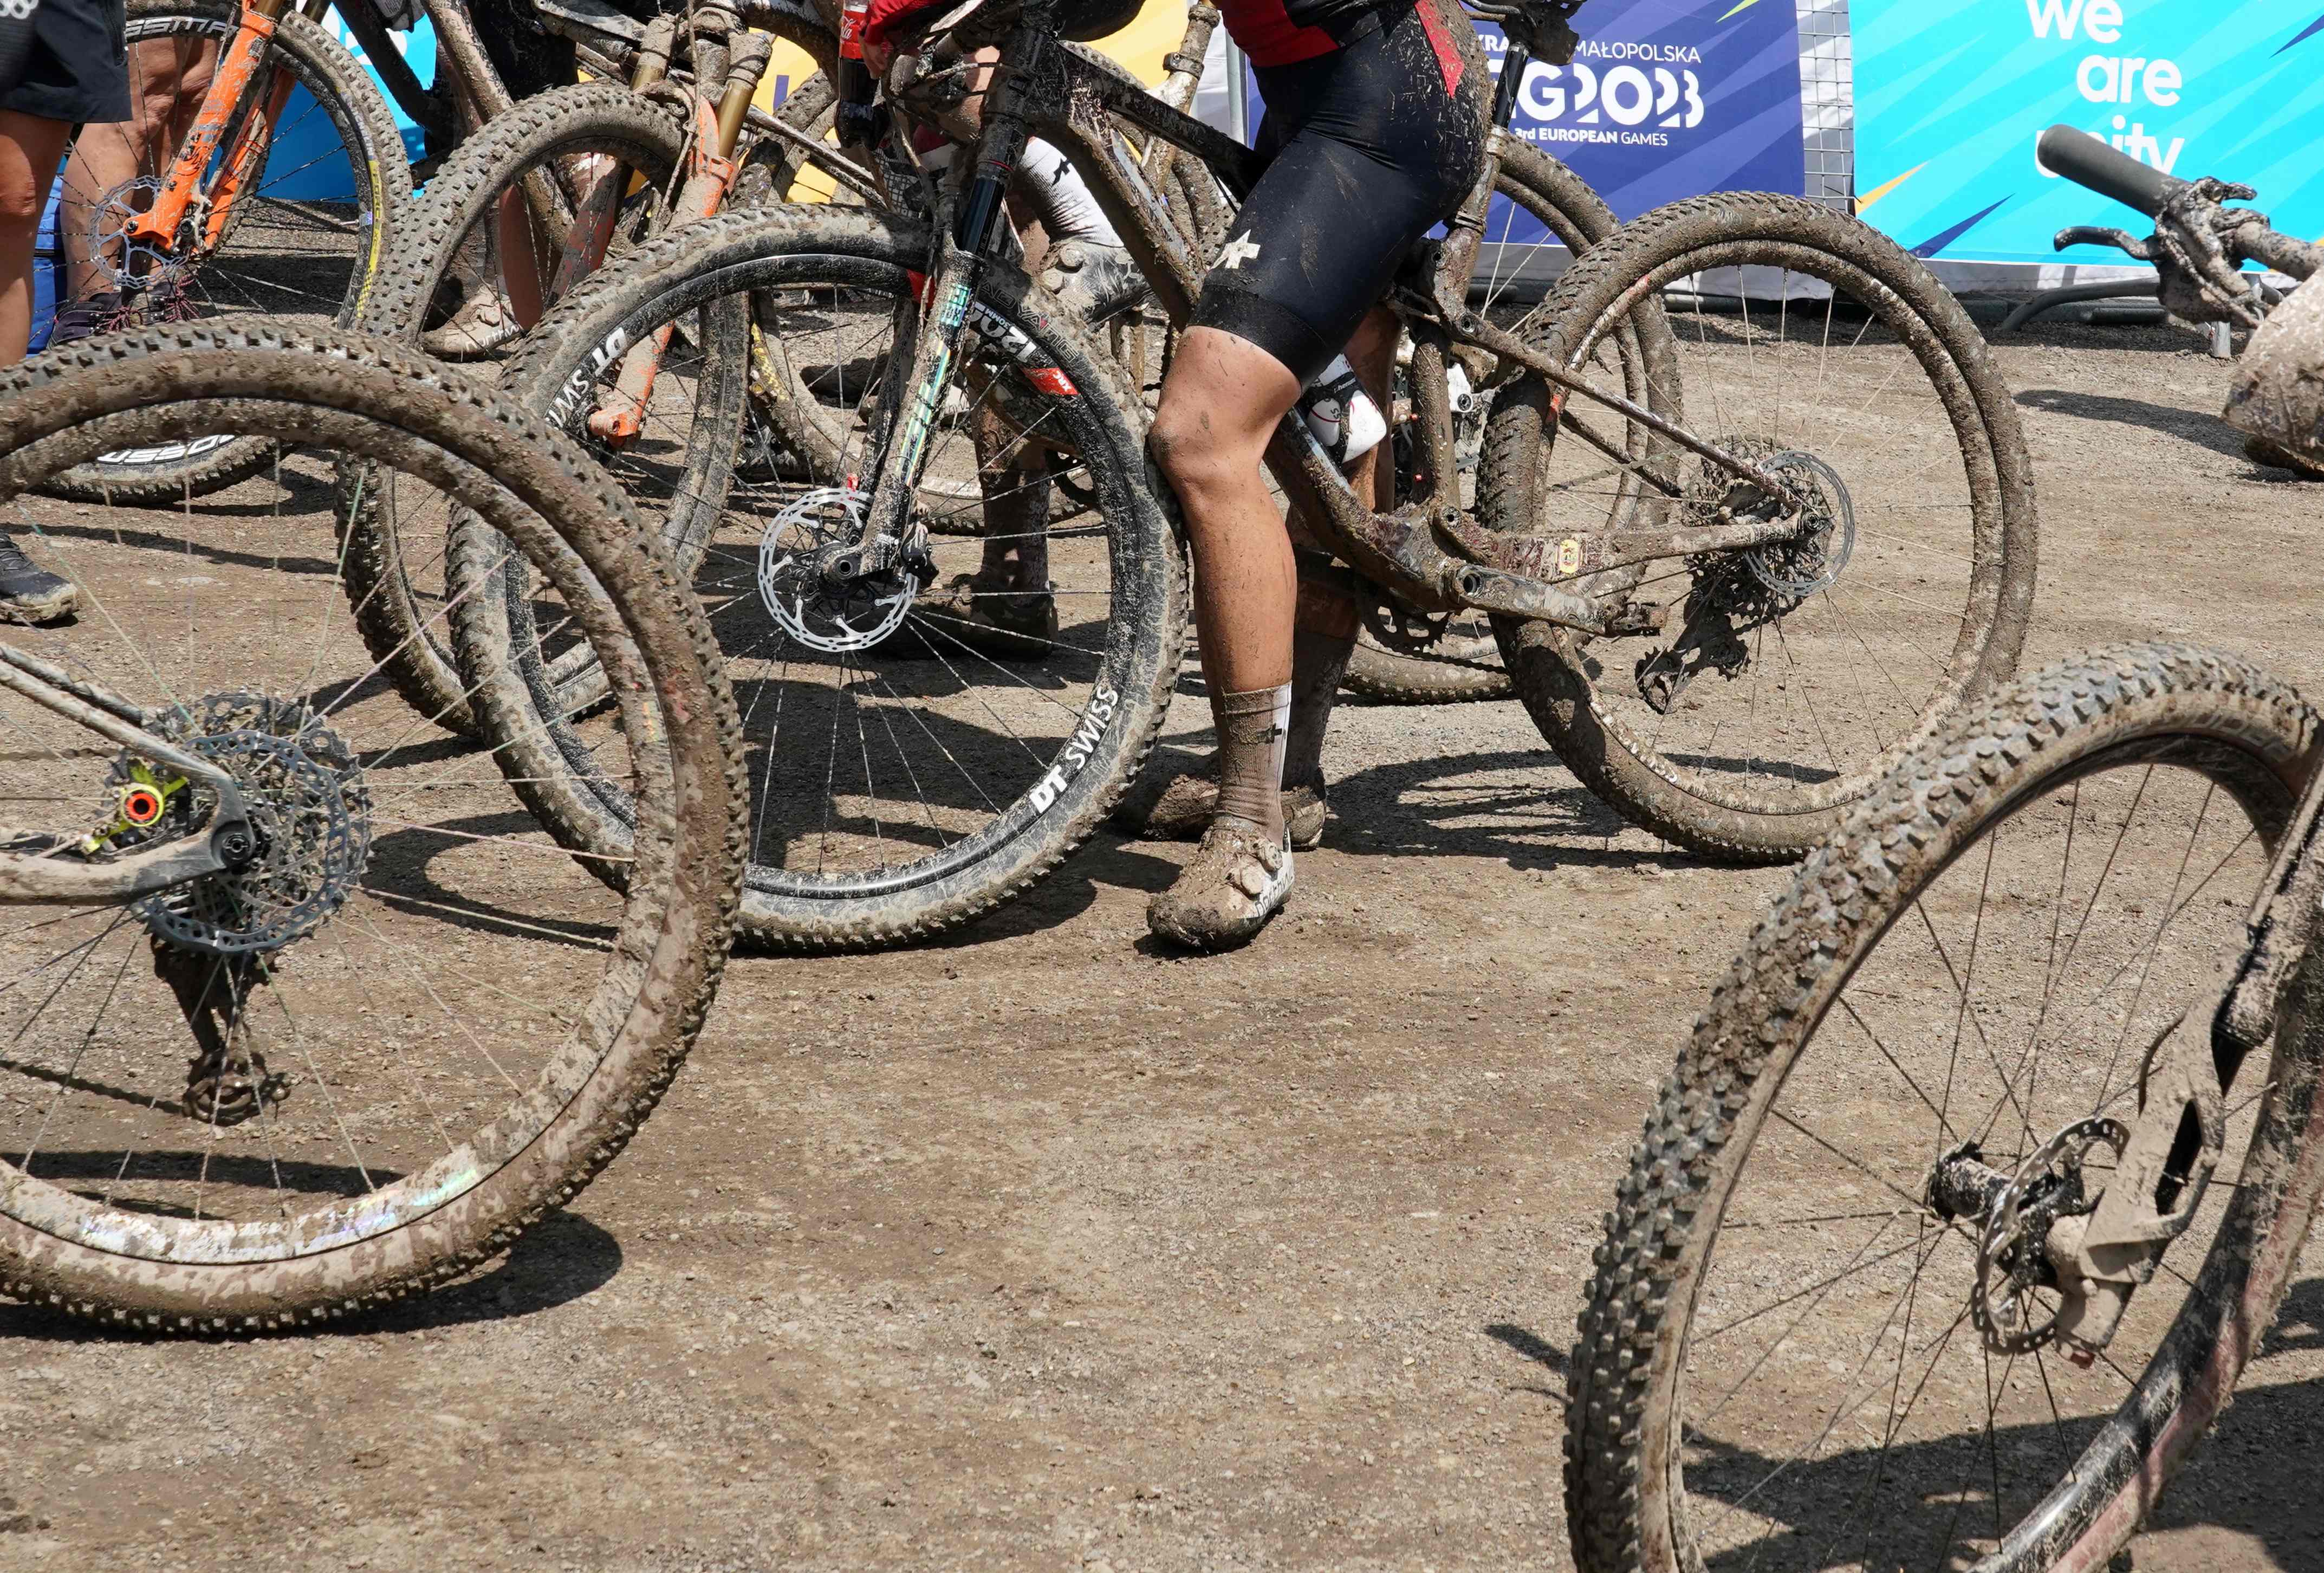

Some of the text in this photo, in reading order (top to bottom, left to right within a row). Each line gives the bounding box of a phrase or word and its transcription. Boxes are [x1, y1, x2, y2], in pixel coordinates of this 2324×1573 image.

[1574, 40, 1702, 64] MAŁOPOLSKA
[2076, 55, 2183, 107] are
[1515, 128, 1668, 146] 3rd EUROPEAN GAMES
[2036, 114, 2185, 178] ity
[984, 307, 1011, 329] 30MM
[592, 327, 627, 377] DT
[1053, 370, 1072, 391] XRC
[1029, 685, 1118, 813] DT SWISS
